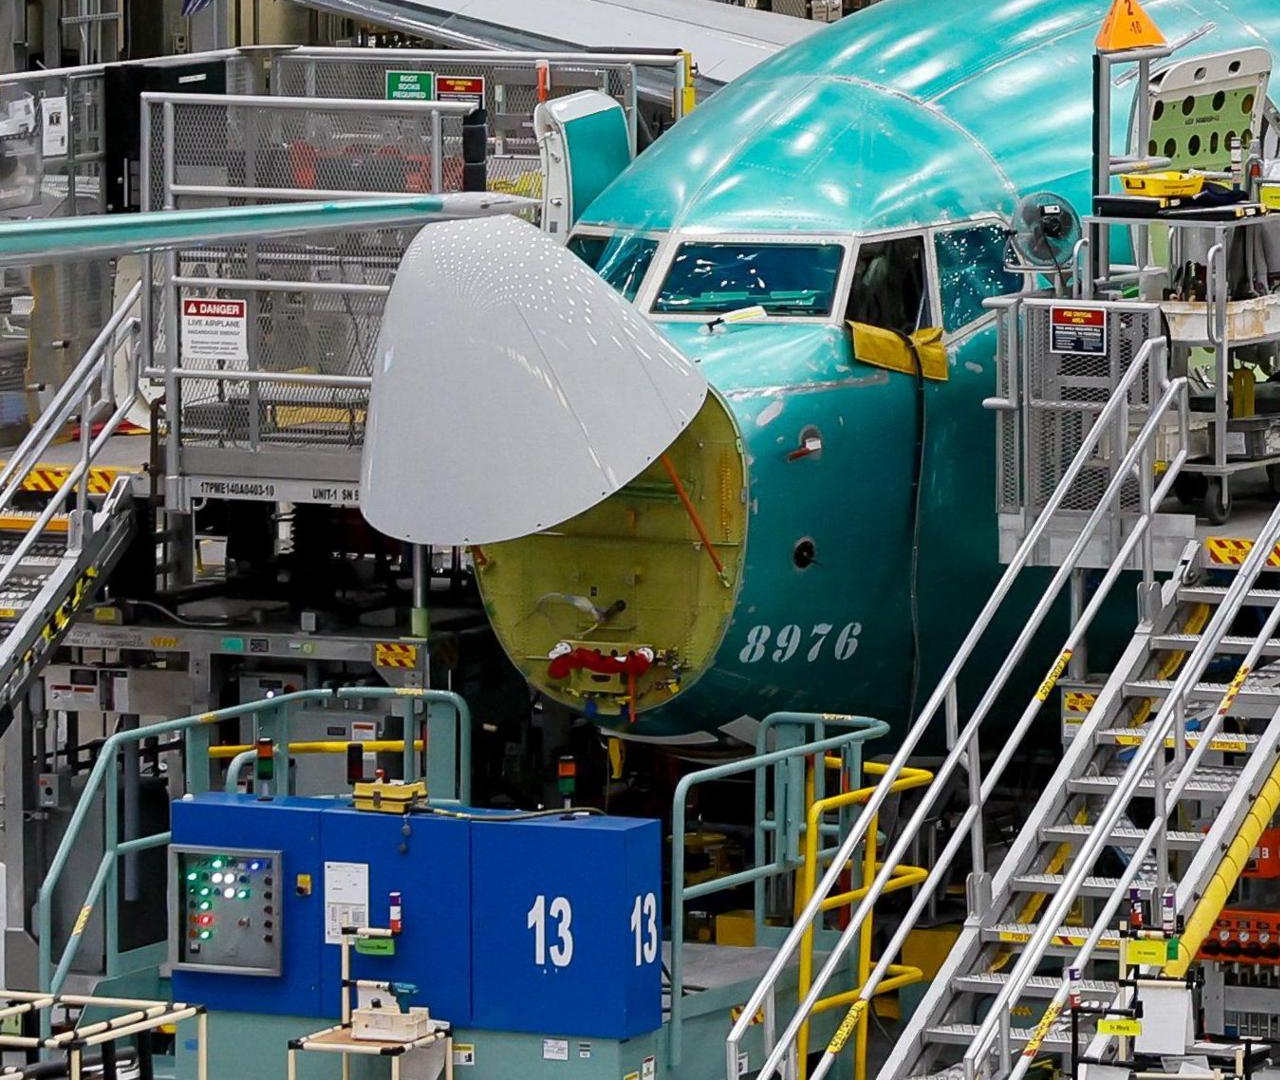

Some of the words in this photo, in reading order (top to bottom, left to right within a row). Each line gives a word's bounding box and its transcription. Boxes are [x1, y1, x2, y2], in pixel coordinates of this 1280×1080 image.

[392, 91, 426, 99] REQUIRED
[200, 304, 240, 315] DANGER
[205, 320, 240, 328] AIRPLANE
[313, 488, 337, 500] UNIT-1
[342, 490, 353, 501] SN
[739, 622, 862, 663] 8976
[1262, 847, 1269, 858] B
[527, 895, 573, 967] 13
[631, 892, 657, 967] 13
